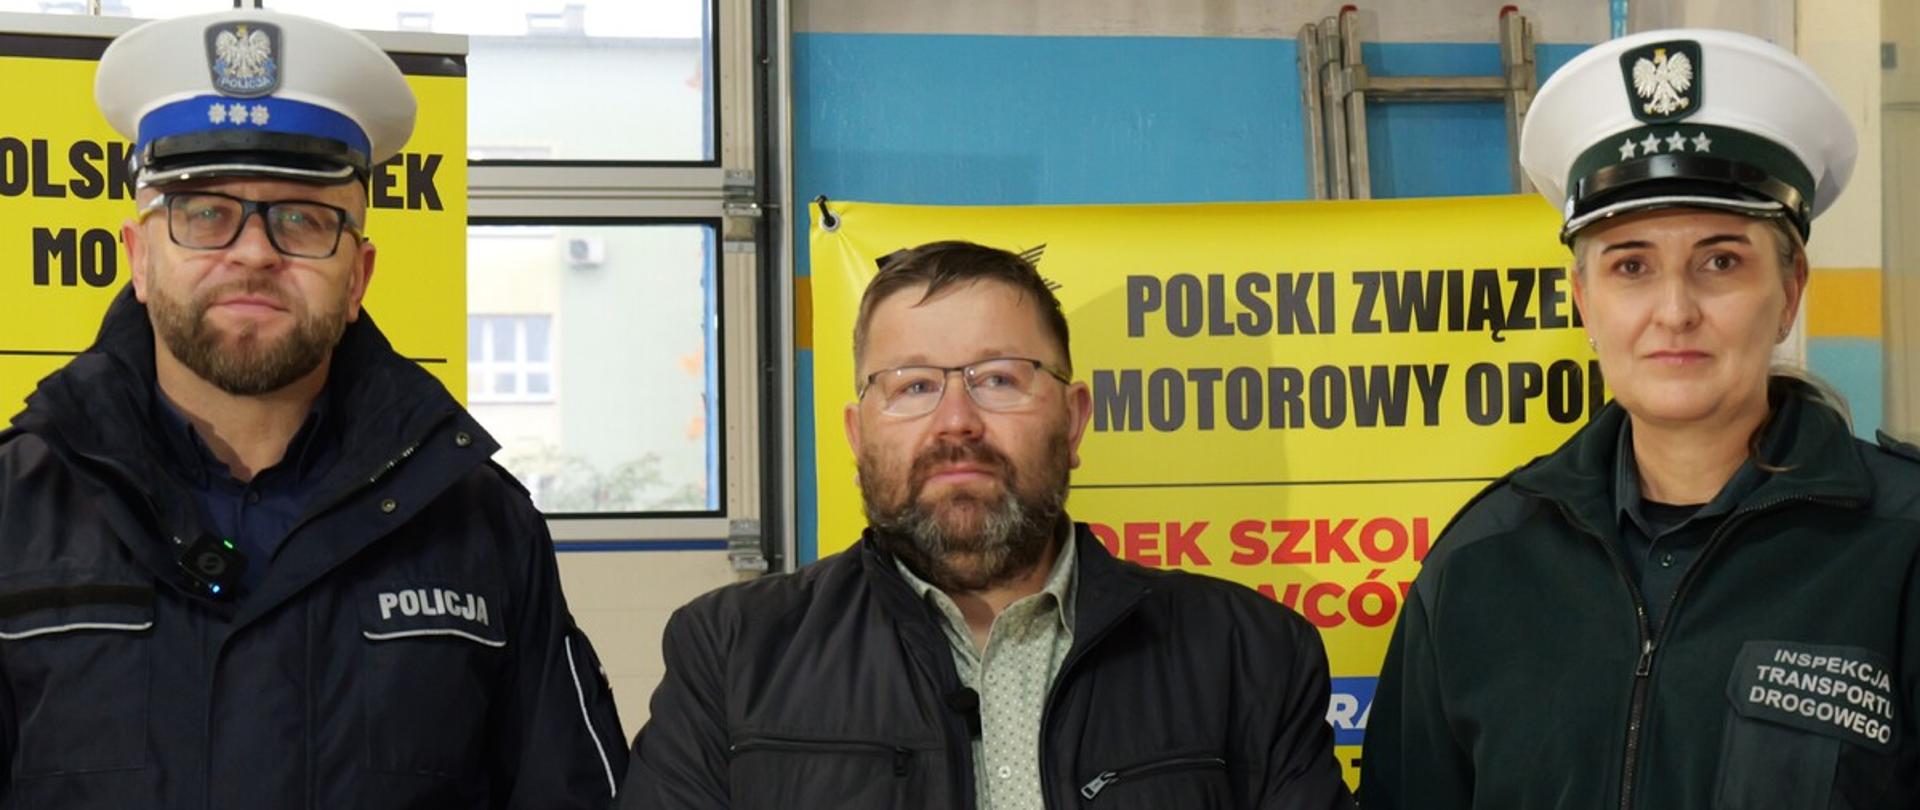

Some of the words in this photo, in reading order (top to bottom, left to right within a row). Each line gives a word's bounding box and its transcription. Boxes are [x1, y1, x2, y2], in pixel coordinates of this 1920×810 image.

[367, 152, 444, 211] EK
[33, 227, 124, 288] MO
[1127, 271, 1336, 338] POLSKI
[1093, 363, 1450, 432] MOTOROWY
[378, 588, 489, 626] POLICJA
[1756, 665, 1895, 720] TRANSPORTU
[1774, 649, 1891, 693] INSPEKCJA
[1749, 685, 1892, 744] DROGOWEGO
